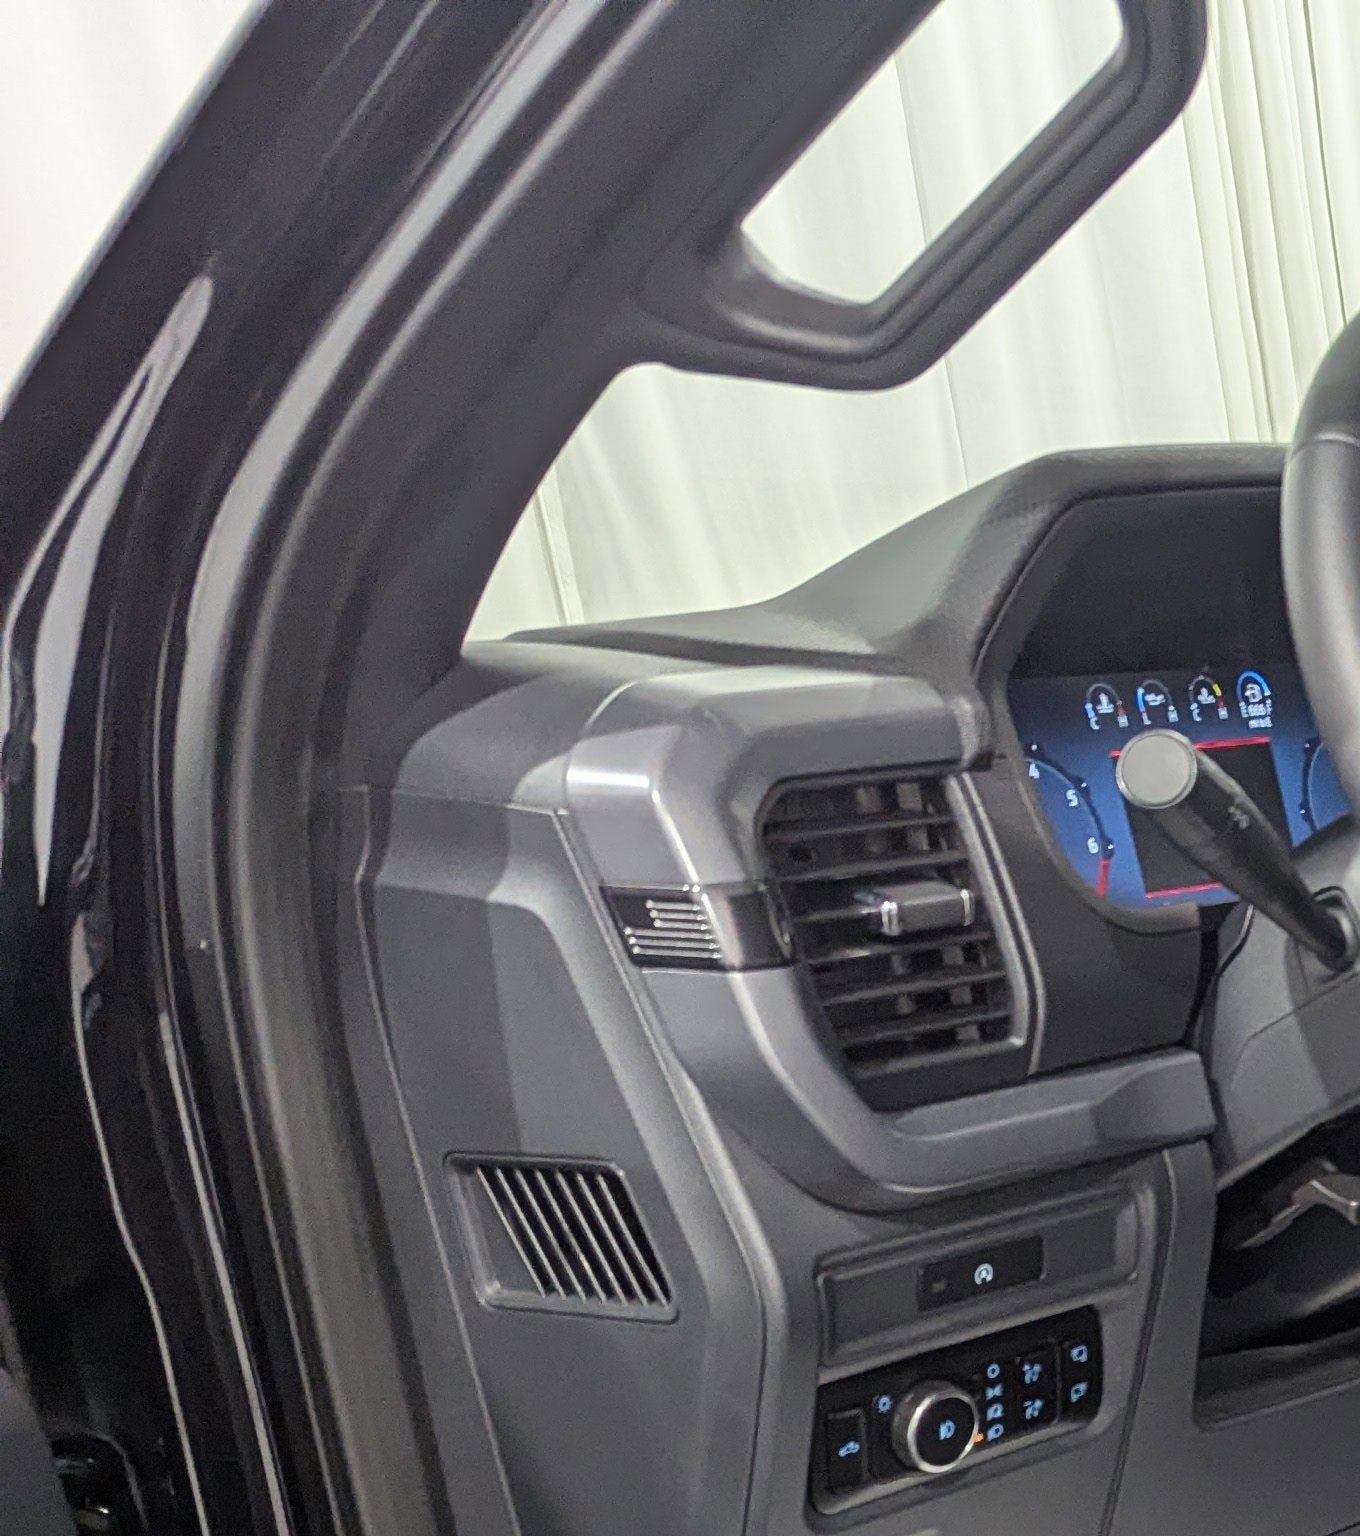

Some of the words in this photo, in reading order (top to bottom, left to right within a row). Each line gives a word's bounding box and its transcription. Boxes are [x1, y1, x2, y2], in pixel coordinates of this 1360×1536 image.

[1029, 763, 1039, 779] 4
[1066, 790, 1078, 806] 5
[1087, 837, 1099, 853] 6
